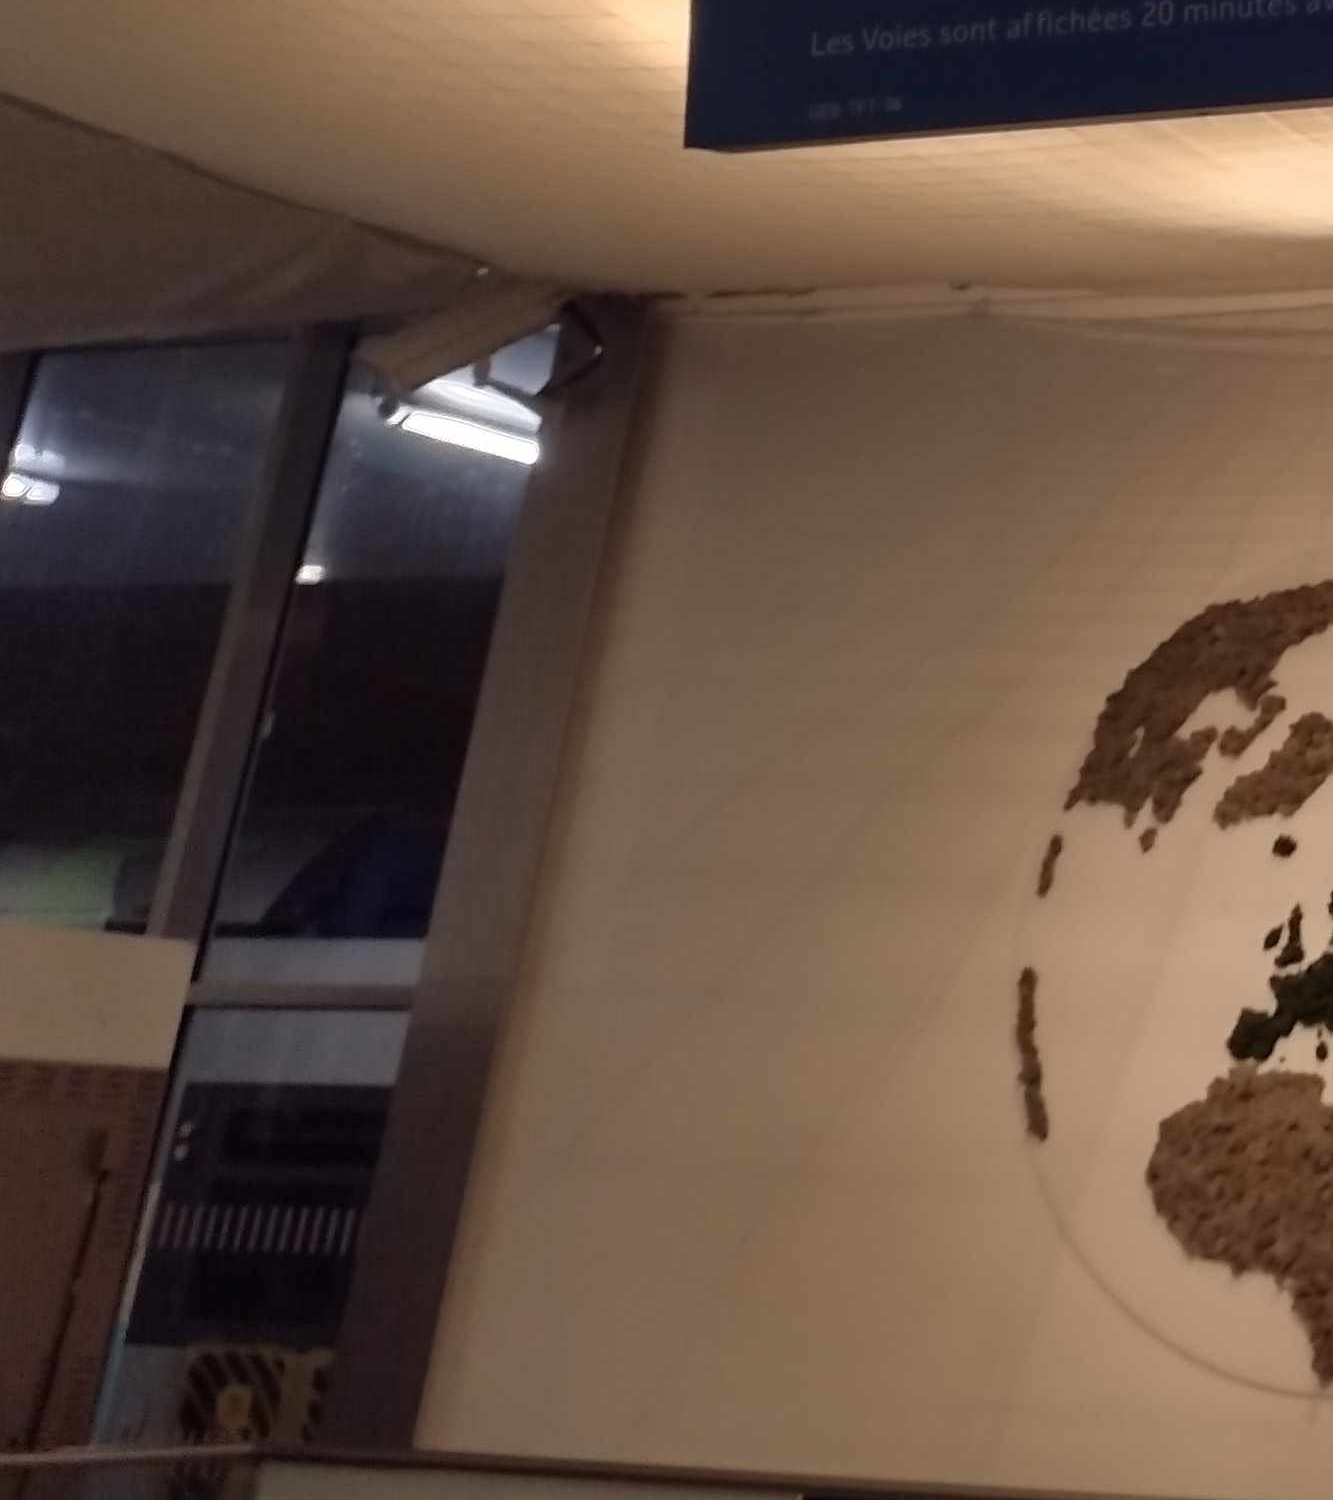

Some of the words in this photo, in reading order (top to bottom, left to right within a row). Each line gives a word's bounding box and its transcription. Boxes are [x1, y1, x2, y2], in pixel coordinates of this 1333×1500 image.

[811, 31, 852, 57] Les
[861, 26, 930, 51] Voies
[940, 20, 998, 45] sont
[1007, 7, 1132, 39] affichées
[1142, 2, 1173, 26] 20
